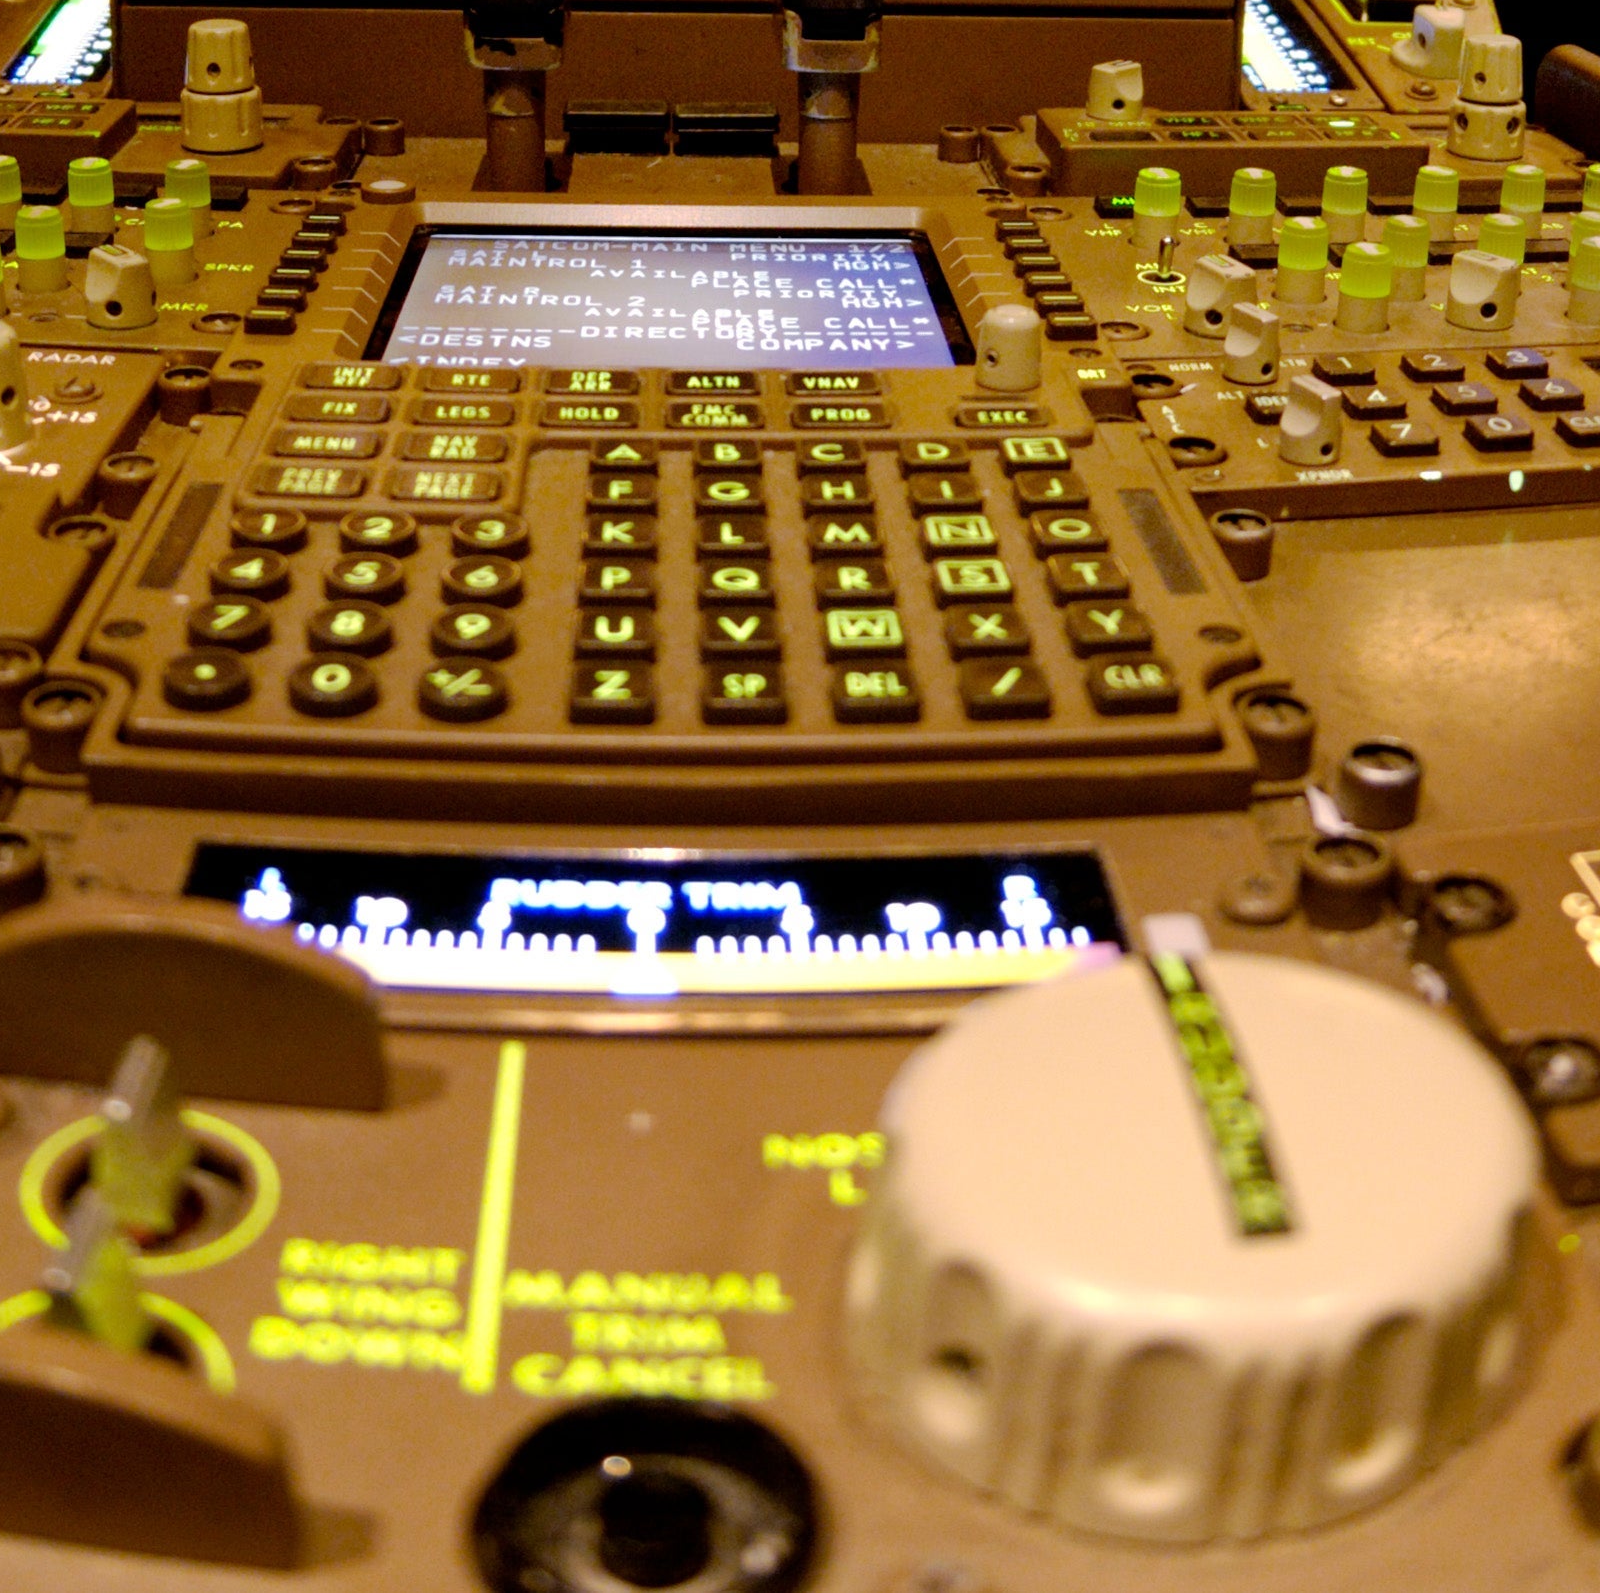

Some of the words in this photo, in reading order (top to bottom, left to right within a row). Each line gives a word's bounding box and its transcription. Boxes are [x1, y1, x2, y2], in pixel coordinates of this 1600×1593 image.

[492, 239, 709, 253] SATCOM-MAIN
[729, 242, 805, 253] MENU
[847, 243, 907, 254] 1/2
[448, 257, 621, 269] MAINTROL
[630, 259, 647, 269] 1
[729, 253, 886, 262] PRIORITY
[204, 263, 254, 272] SPKR
[589, 270, 772, 279] AVAILABLE
[691, 278, 793, 289] PLACE
[1152, 285, 1186, 293] INT
[434, 293, 612, 306] MAINTROL
[628, 296, 647, 307] 2
[732, 289, 898, 299] PRIORITY
[159, 302, 209, 311] MKR
[584, 308, 774, 318] AVAILABLE
[692, 316, 803, 330] PLACE
[27, 352, 117, 366] RADAR
[1337, 357, 1354, 371] 1
[1422, 355, 1449, 367] 2
[1506, 351, 1529, 364] 3
[570, 371, 611, 382] DEP
[1168, 361, 1214, 374] NORM
[452, 374, 490, 386] RTE
[686, 376, 741, 389] ALTN
[802, 377, 860, 389] VNAV
[1544, 381, 1566, 394] 6
[1216, 390, 1244, 403] ALT
[1367, 390, 1389, 403] 4
[1457, 385, 1477, 399] 5
[322, 402, 357, 415] FIX
[435, 406, 490, 419] LEGS
[559, 407, 619, 420] HOLD
[691, 404, 736, 415] FMC
[810, 408, 871, 422] PROG
[977, 410, 1029, 424] EXEC
[1390, 423, 1413, 439] 7
[1487, 417, 1513, 432] 0
[292, 437, 356, 450] MENU
[433, 435, 478, 447] NAV
[604, 443, 646, 463] A
[713, 443, 741, 462] B
[810, 443, 845, 462] C
[916, 442, 950, 461] D
[414, 472, 477, 485] NEXT
[1045, 477, 1064, 497] J
[412, 484, 473, 499] PAGE
[608, 479, 633, 501] F
[707, 480, 750, 501] G
[821, 481, 856, 499] H
[261, 513, 277, 535] 1
[362, 516, 394, 539] 2
[475, 519, 506, 541] 3
[601, 520, 636, 543] K
[720, 522, 745, 545] L
[823, 522, 871, 543] M
[1047, 517, 1092, 539] O
[230, 557, 263, 579] 4
[343, 561, 380, 585] 5
[464, 565, 499, 589] 6
[1071, 561, 1100, 587] T
[601, 566, 631, 590] P
[711, 567, 761, 591] Q
[836, 566, 872, 591] R
[211, 604, 249, 630] 7
[330, 609, 366, 636] 8
[454, 613, 491, 640] 9
[968, 612, 1008, 639] X
[1087, 609, 1124, 635] Y
[594, 615, 635, 643] U
[717, 615, 760, 642] V
[311, 662, 352, 693] 0
[592, 669, 632, 700] Z
[722, 673, 767, 698] SP
[844, 671, 908, 697] DEL
[1102, 664, 1168, 690] CLR
[490, 878, 672, 910] RUDDER
[682, 879, 803, 910] TRIM
[761, 1132, 887, 1170] NOS
[278, 1236, 468, 1286] RIGHT
[504, 1269, 796, 1314] MANUAL
[276, 1275, 461, 1329] WING
[565, 1311, 727, 1354] TRIM
[247, 1313, 468, 1374] DOWN
[510, 1353, 778, 1401] CANCEL
